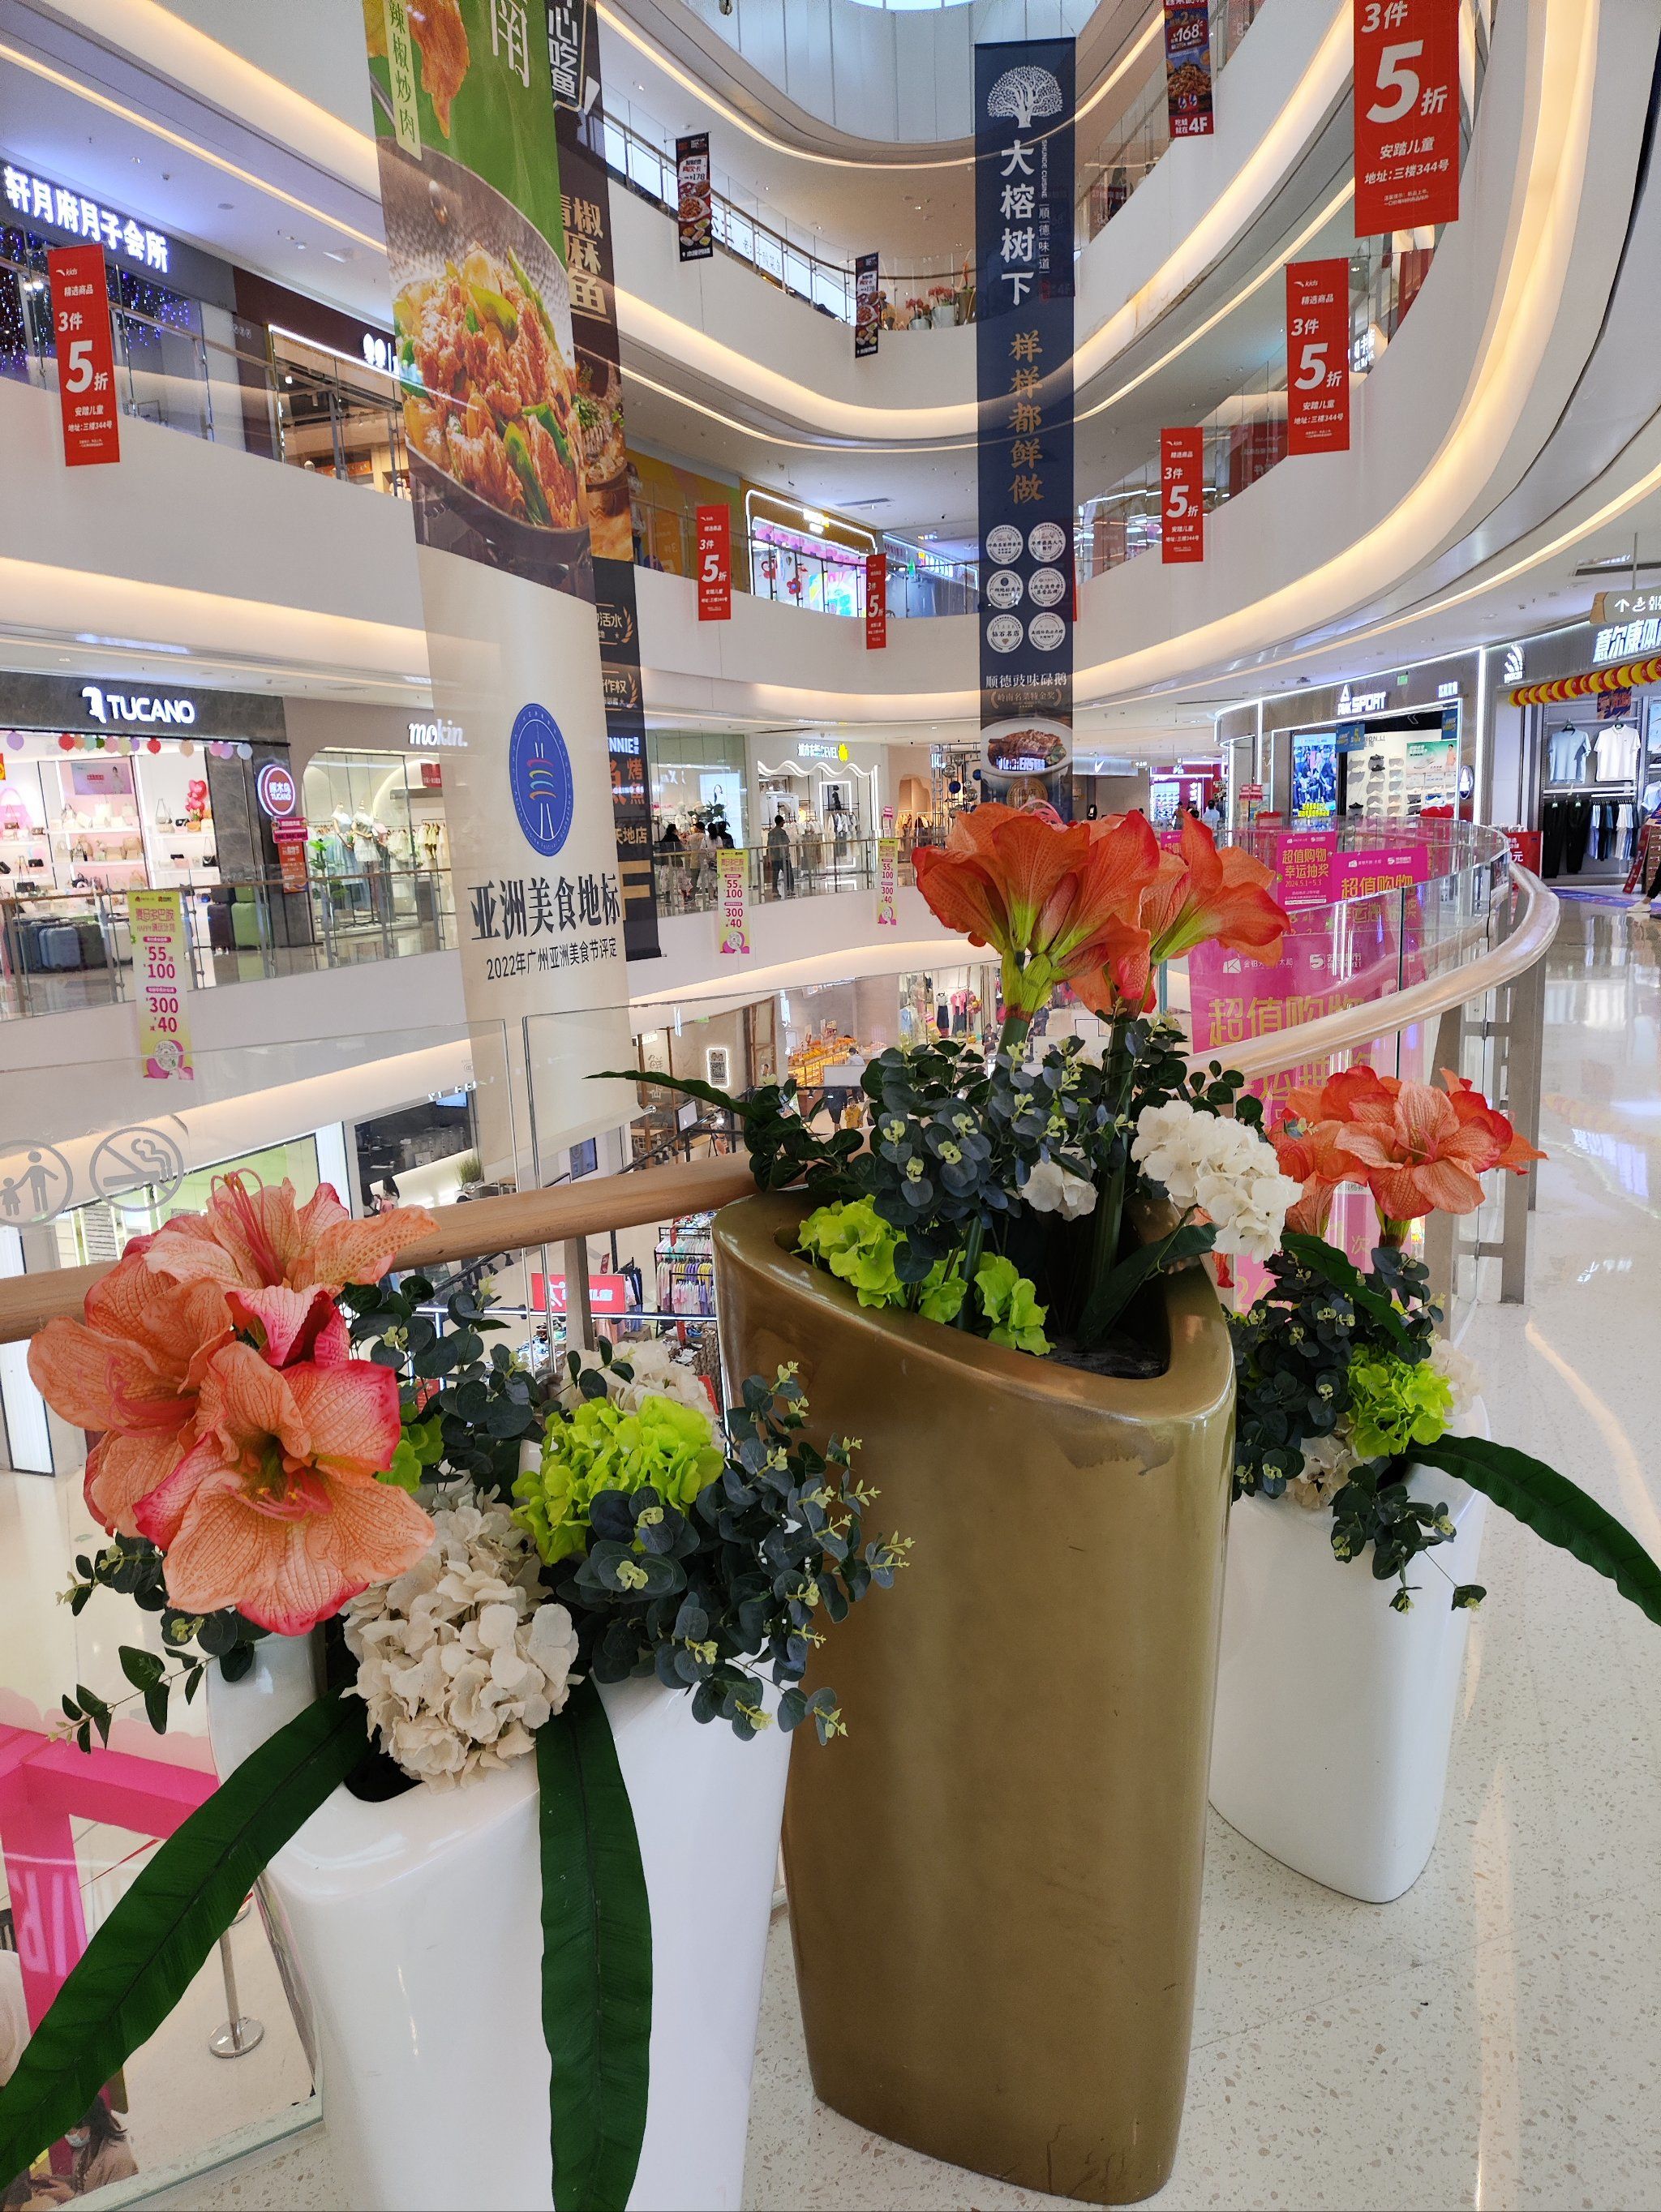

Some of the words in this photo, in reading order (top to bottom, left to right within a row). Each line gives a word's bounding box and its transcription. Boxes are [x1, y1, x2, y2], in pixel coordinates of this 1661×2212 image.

[1360, 0, 1408, 33] 3件
[1366, 39, 1448, 124] 5折
[1189, 116, 1208, 134] 4F
[1380, 135, 1436, 160] 安踏儿童
[1000, 139, 1035, 306] 大榕树下
[1301, 294, 1334, 306] 精选商品
[58, 311, 83, 332] 3件
[1291, 318, 1320, 337] 3件
[65, 340, 109, 393] 5折
[1294, 342, 1342, 390] 5折
[1007, 329, 1045, 504] 样样都鲜做
[1164, 467, 1183, 480] 3件
[1165, 485, 1199, 518] 5折
[699, 539, 714, 550] 3件
[702, 554, 727, 583] 5折
[1592, 618, 1661, 663] 意尔康体
[985, 672, 1067, 688] 顺德豉味碌鹅
[106, 694, 195, 724] TUCANO
[1351, 692, 1387, 714] SPORT
[1281, 848, 1327, 864] 超值购物
[1285, 864, 1329, 878] 幸运抽奖
[726, 890, 743, 898] 100
[467, 872, 620, 941] 亚洲美食地标
[726, 908, 744, 917] 300
[487, 937, 617, 980] 2022年广州亚洲美食节评定
[148, 963, 175, 979] 100
[148, 997, 178, 1014] 300
